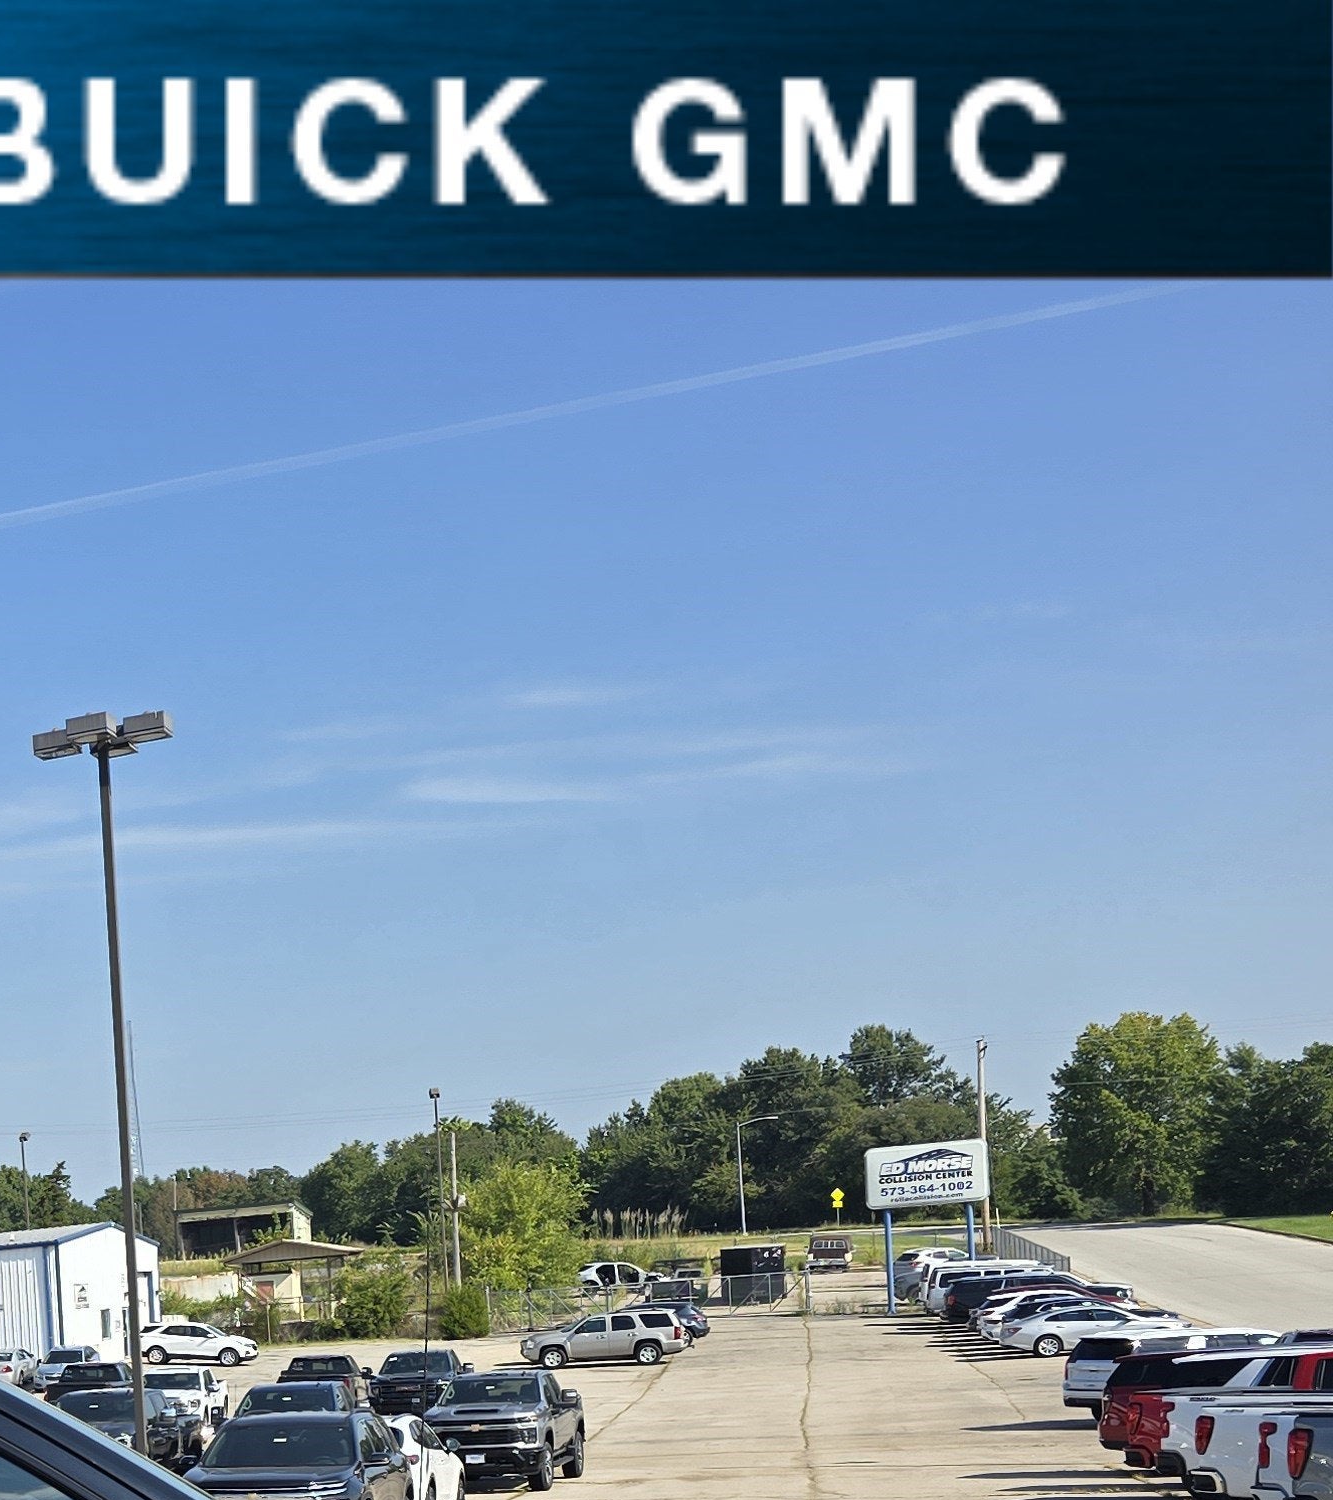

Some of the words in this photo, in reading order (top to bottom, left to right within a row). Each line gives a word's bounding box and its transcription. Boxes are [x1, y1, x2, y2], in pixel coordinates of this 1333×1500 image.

[879, 1162, 905, 1177] ED
[907, 1155, 973, 1174] MORSE
[879, 1173, 933, 1185] COLLISION
[935, 1170, 973, 1180] CENTER
[880, 1180, 974, 1197] 573-364-1002
